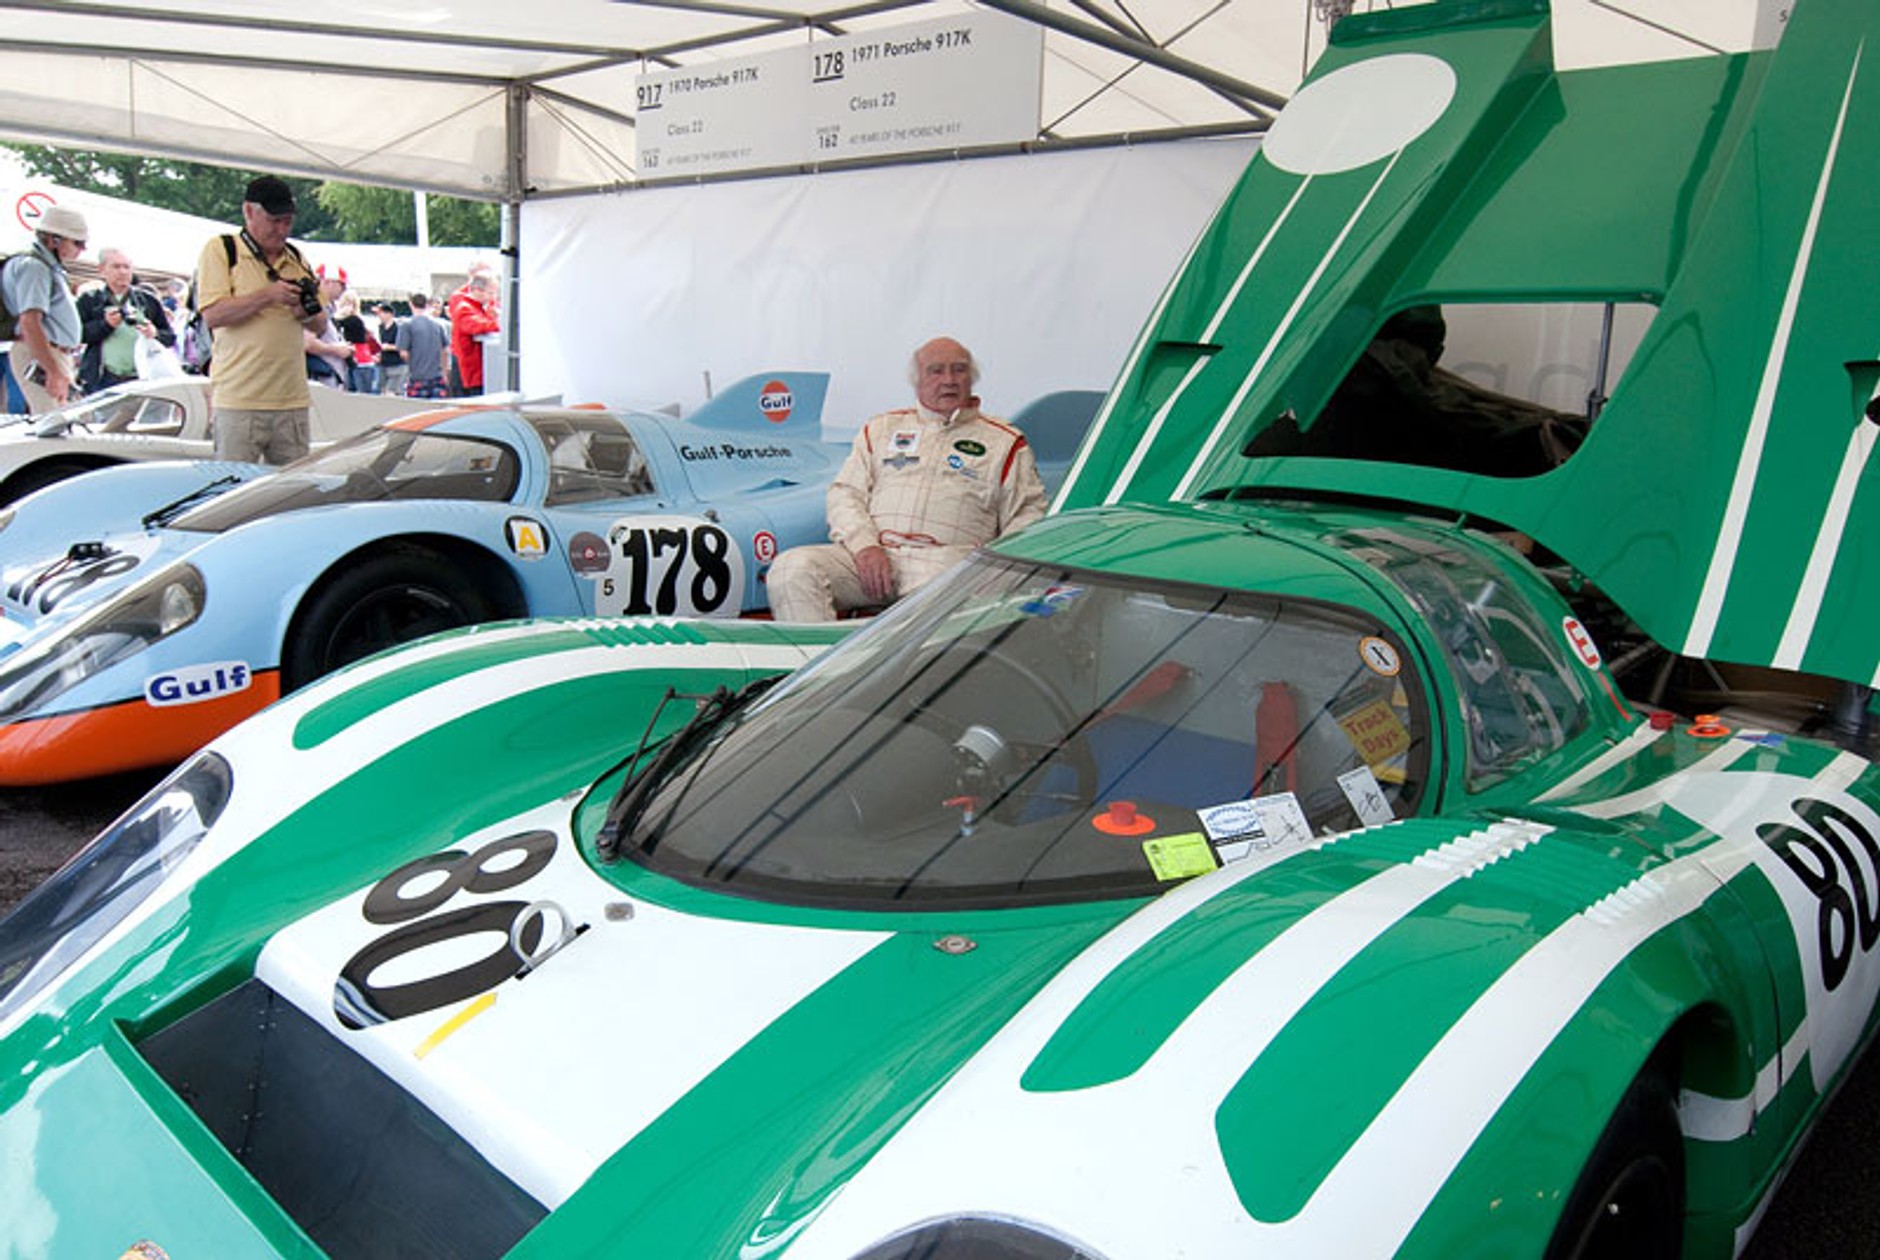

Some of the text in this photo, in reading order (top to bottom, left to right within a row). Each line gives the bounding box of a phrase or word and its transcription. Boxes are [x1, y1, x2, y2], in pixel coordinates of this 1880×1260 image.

[853, 29, 972, 63] 1971 Porsche 917K
[814, 51, 844, 77] 178
[669, 67, 759, 94] 1970 Porsche 917K
[637, 84, 663, 106] 917
[850, 92, 896, 111] Class 22
[667, 119, 703, 136] Class 22
[819, 134, 838, 149] 162
[761, 395, 792, 409] Gulf
[681, 444, 792, 461] Gulf-Porsche
[518, 526, 541, 550] A
[760, 541, 770, 556] E
[623, 525, 731, 616] 178
[603, 578, 615, 596] 5
[1565, 620, 1599, 666] E
[150, 665, 247, 701] Gulf
[1346, 707, 1392, 737] Track
[1361, 730, 1399, 754] Days
[1755, 797, 1880, 992] 80
[334, 829, 559, 1031] 80
